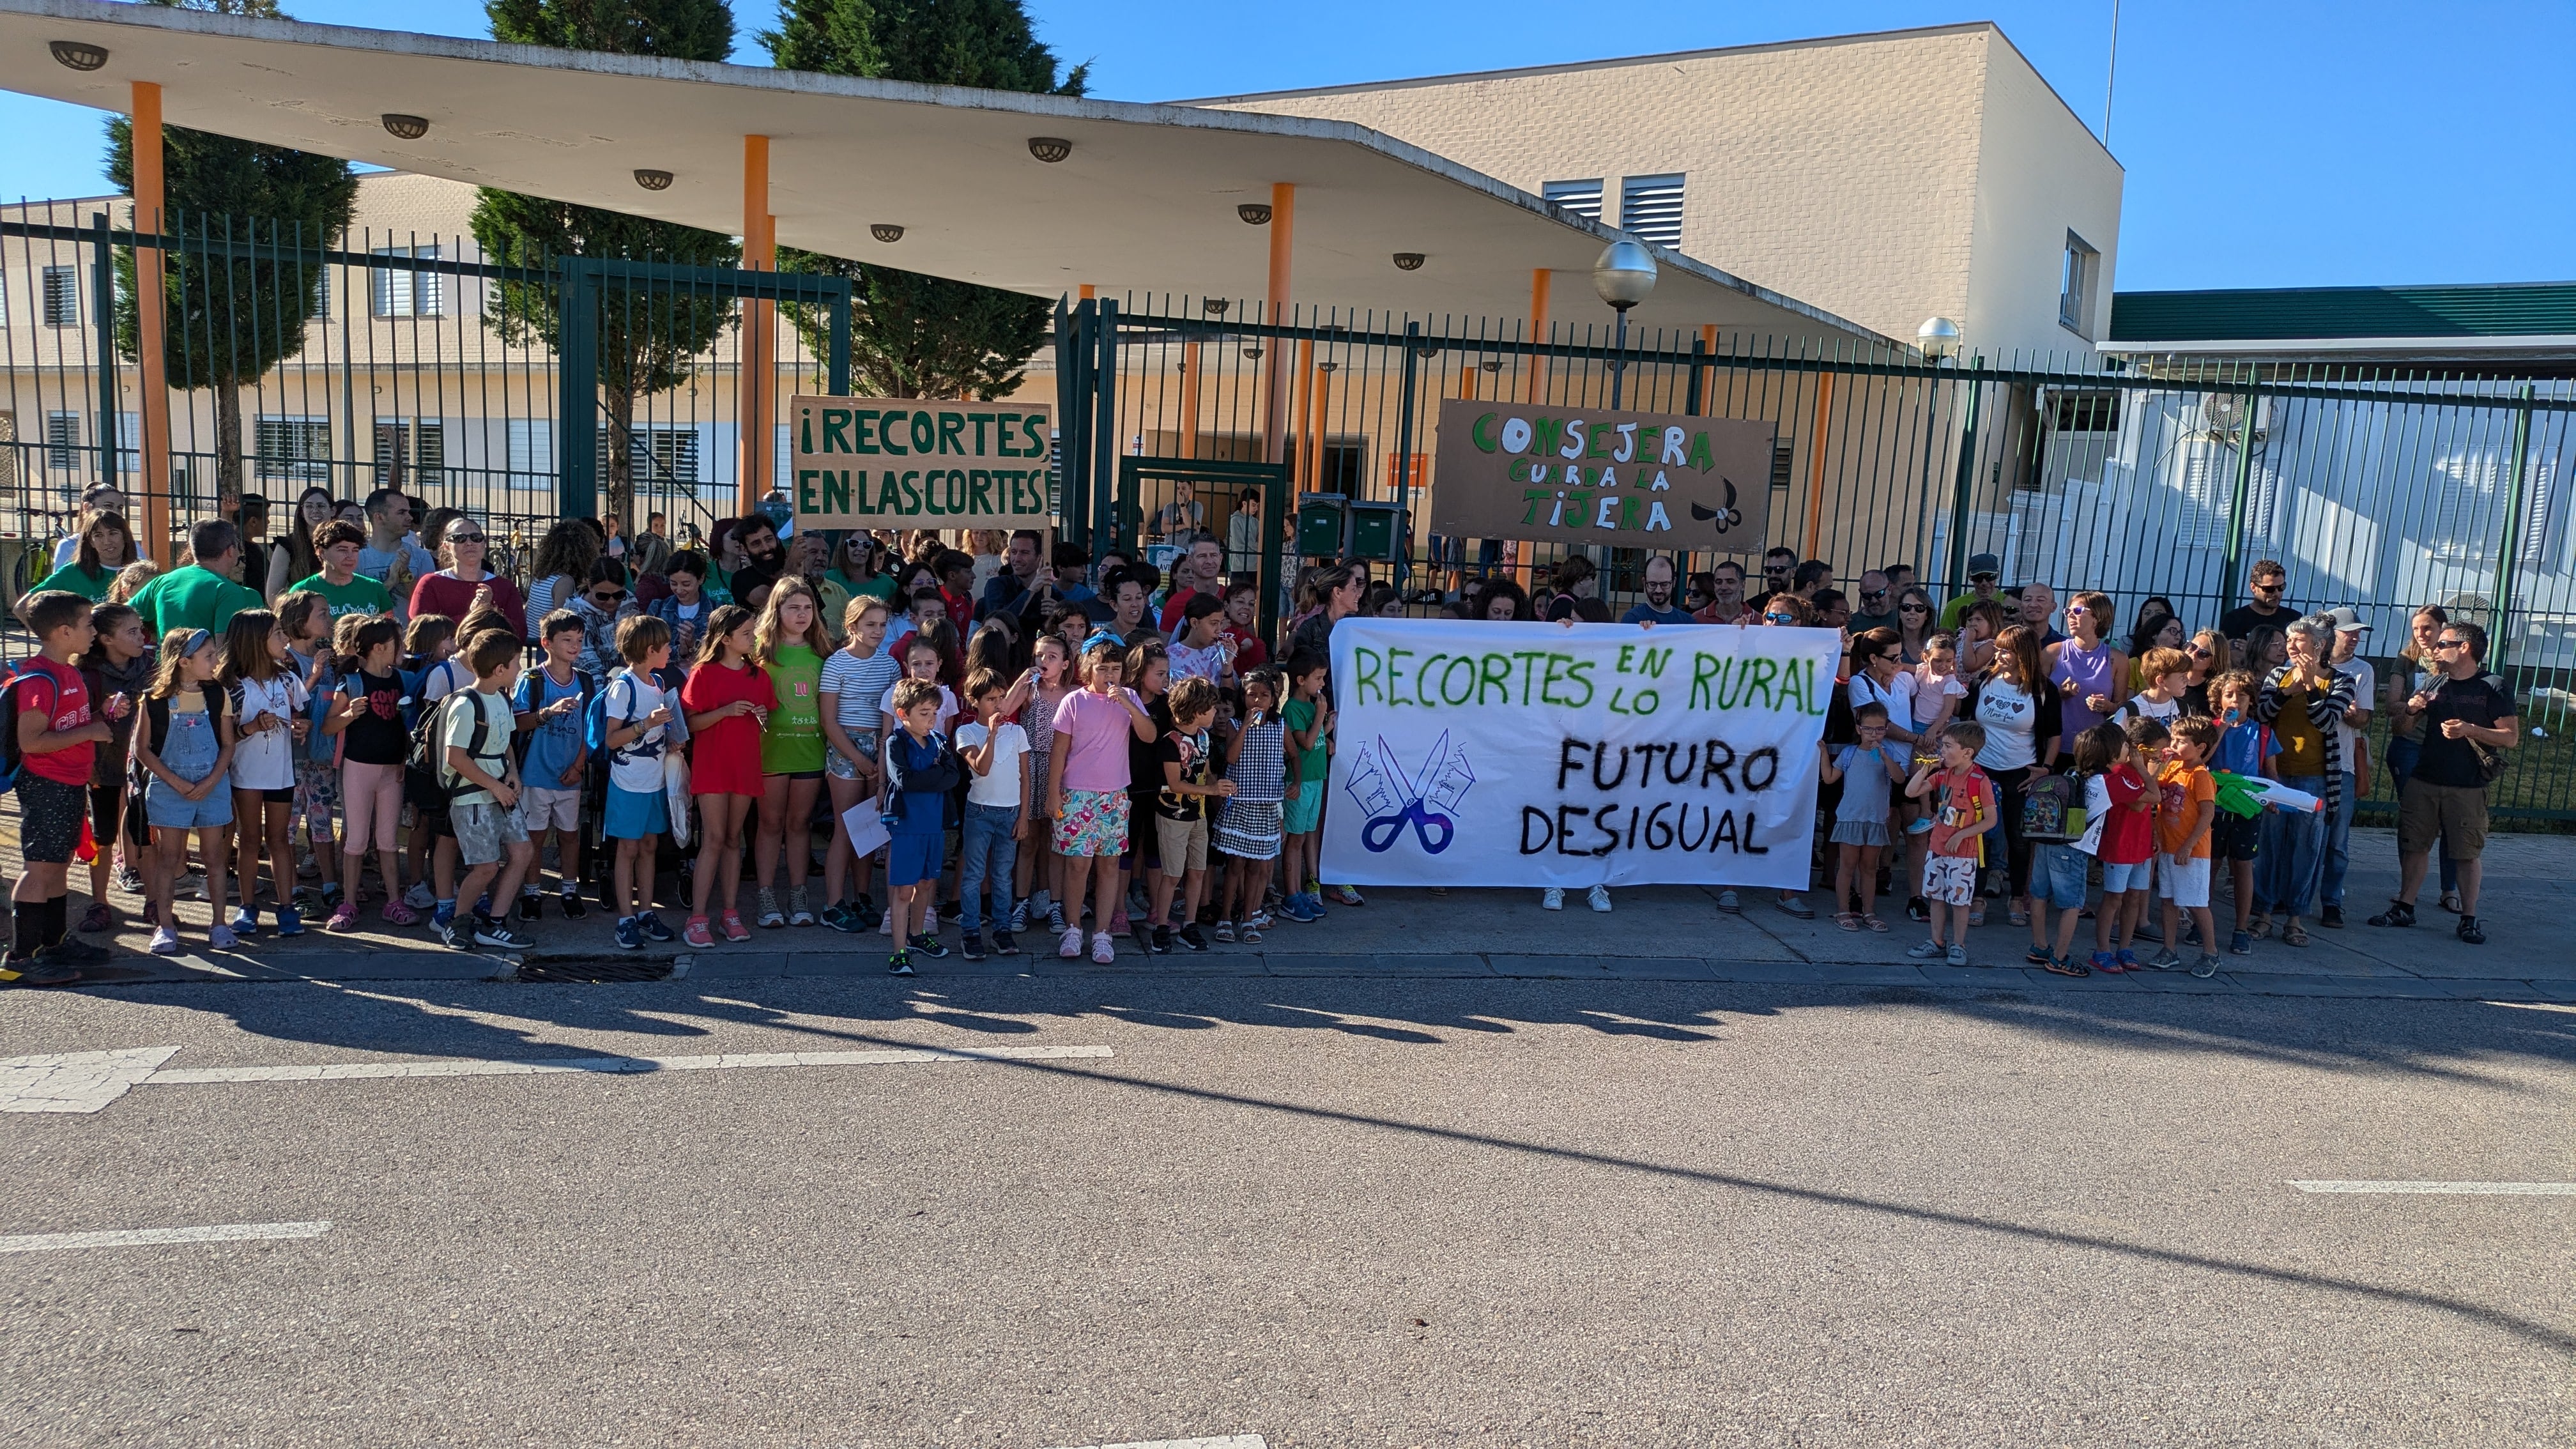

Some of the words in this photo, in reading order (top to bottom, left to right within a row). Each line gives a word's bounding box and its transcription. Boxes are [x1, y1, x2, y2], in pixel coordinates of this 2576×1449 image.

[1473, 412, 1716, 474] CONSEJERA
[1508, 457, 1618, 488] GUARDA
[1635, 468, 1670, 493] LA
[794, 681, 809, 697] 10
[1354, 647, 1595, 709] RECORTES
[1617, 645, 1674, 679] EN
[1688, 652, 1825, 716] RURAL
[1609, 686, 1660, 716] LO
[1556, 737, 1779, 794] FUTURO
[1519, 801, 1770, 857] DESIGUAL
